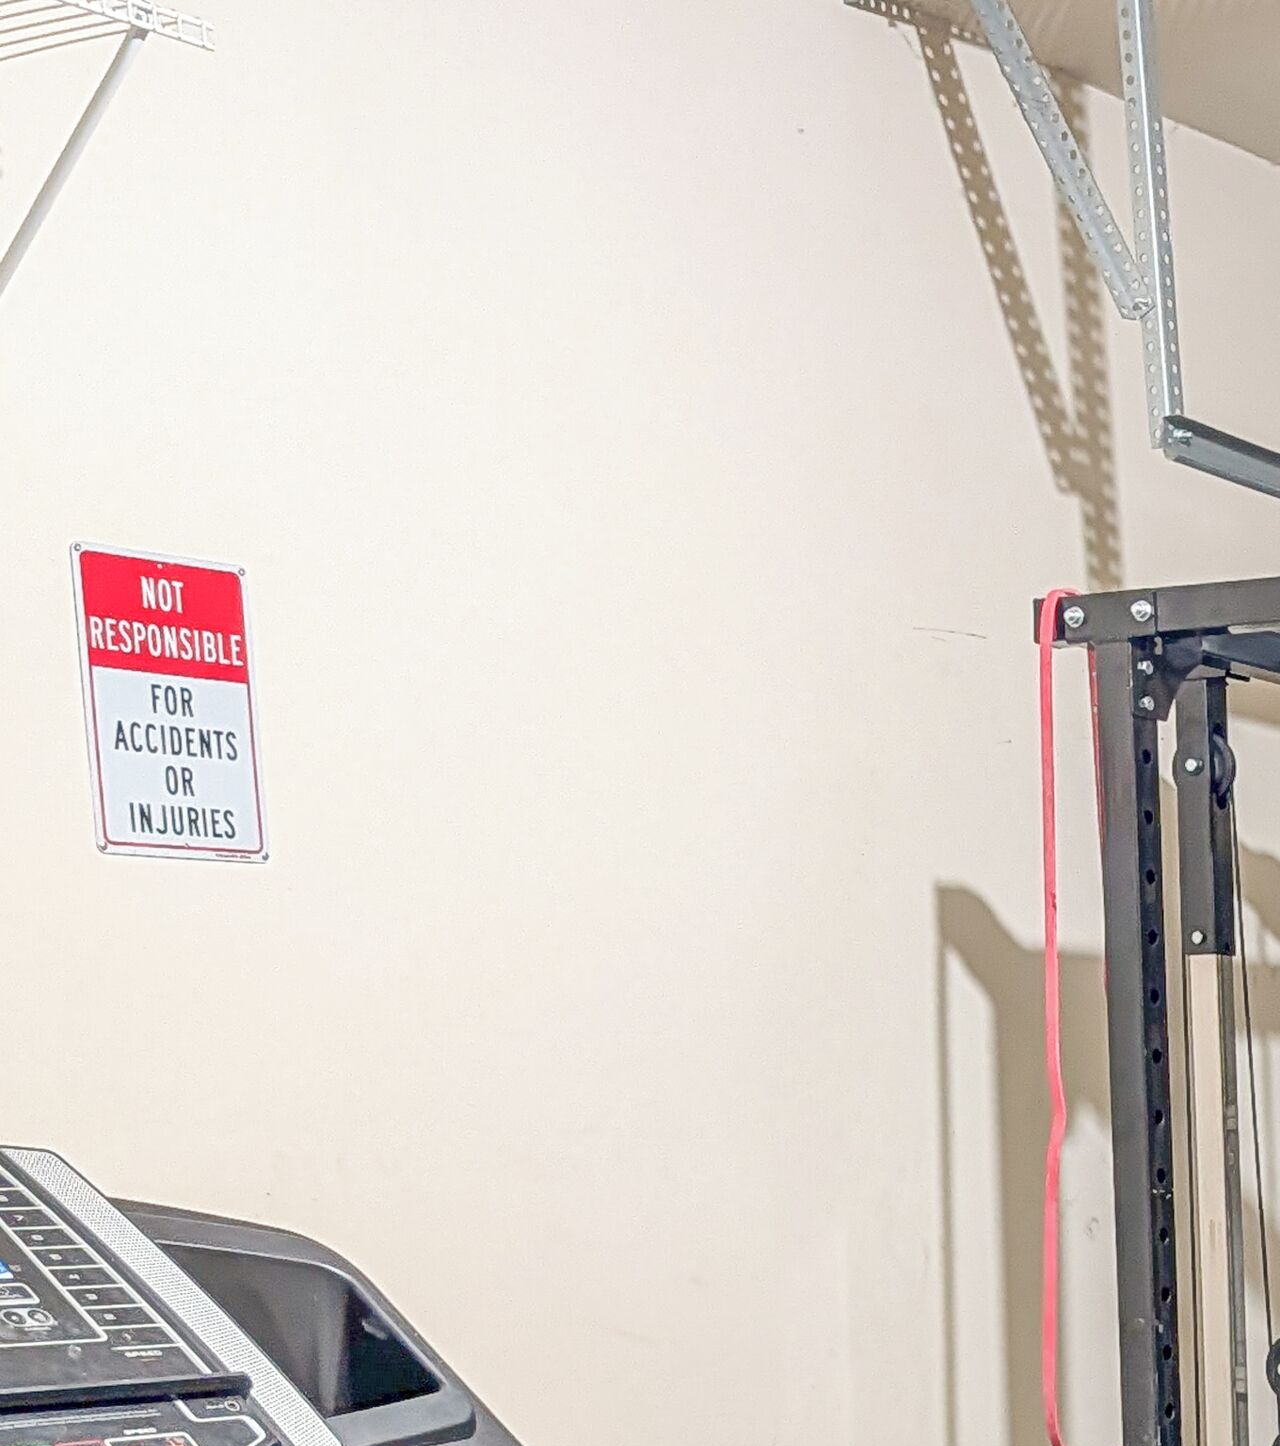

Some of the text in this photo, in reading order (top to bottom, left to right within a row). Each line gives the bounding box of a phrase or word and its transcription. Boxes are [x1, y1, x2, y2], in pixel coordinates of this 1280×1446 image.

[140, 576, 184, 615] NOT
[89, 616, 244, 668] RESPONSIBLE
[151, 684, 194, 718] FOR
[114, 720, 238, 762] ACCIDENTS
[166, 766, 195, 797] OR
[129, 802, 236, 840] INJURIES
